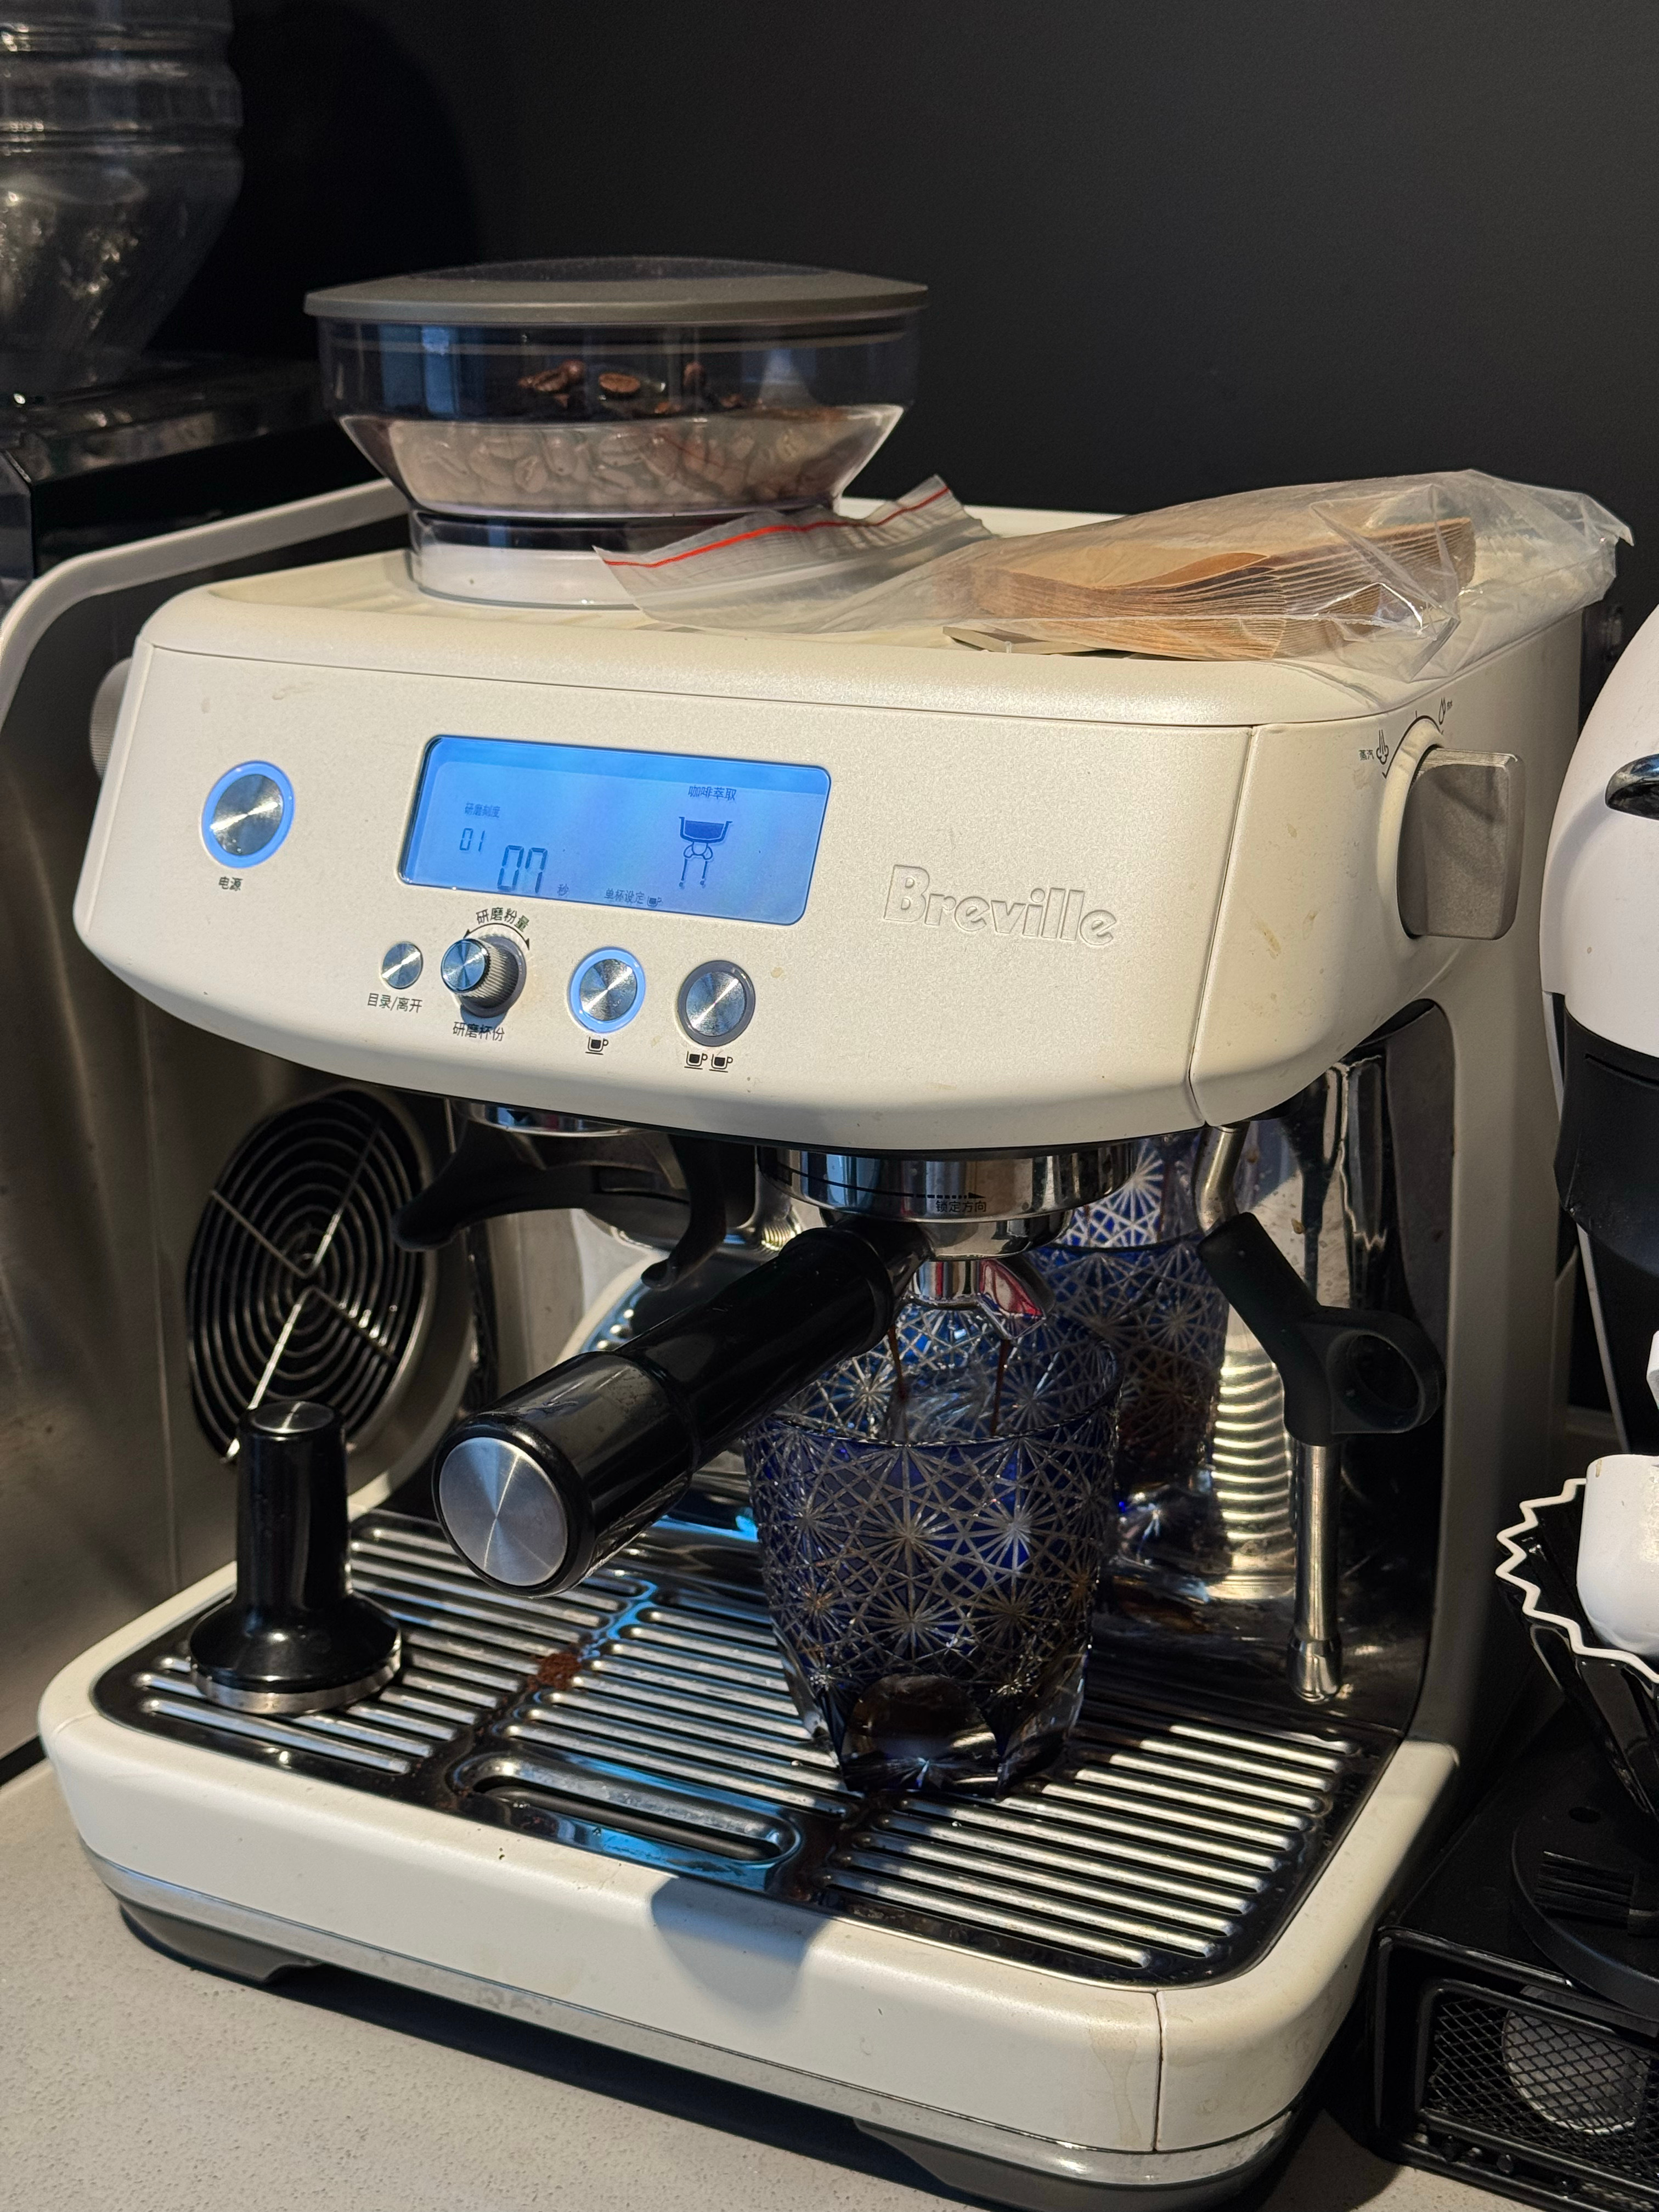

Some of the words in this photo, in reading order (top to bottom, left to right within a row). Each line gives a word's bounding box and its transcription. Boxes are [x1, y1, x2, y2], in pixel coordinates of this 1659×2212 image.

[687, 785, 737, 801] 咖啡萃取
[464, 802, 501, 819] 研磨刻度
[459, 827, 486, 852] 01
[496, 844, 548, 894] 07
[556, 883, 569, 896] 秒
[218, 876, 243, 891] 电源
[603, 888, 645, 905] 单杯设定
[882, 863, 1118, 946] Breville
[475, 906, 530, 933] 研磨粉量
[366, 992, 423, 1014] 目录/离开
[452, 1021, 505, 1042] 研磨杯份
[935, 1200, 988, 1213] 锁定方向
